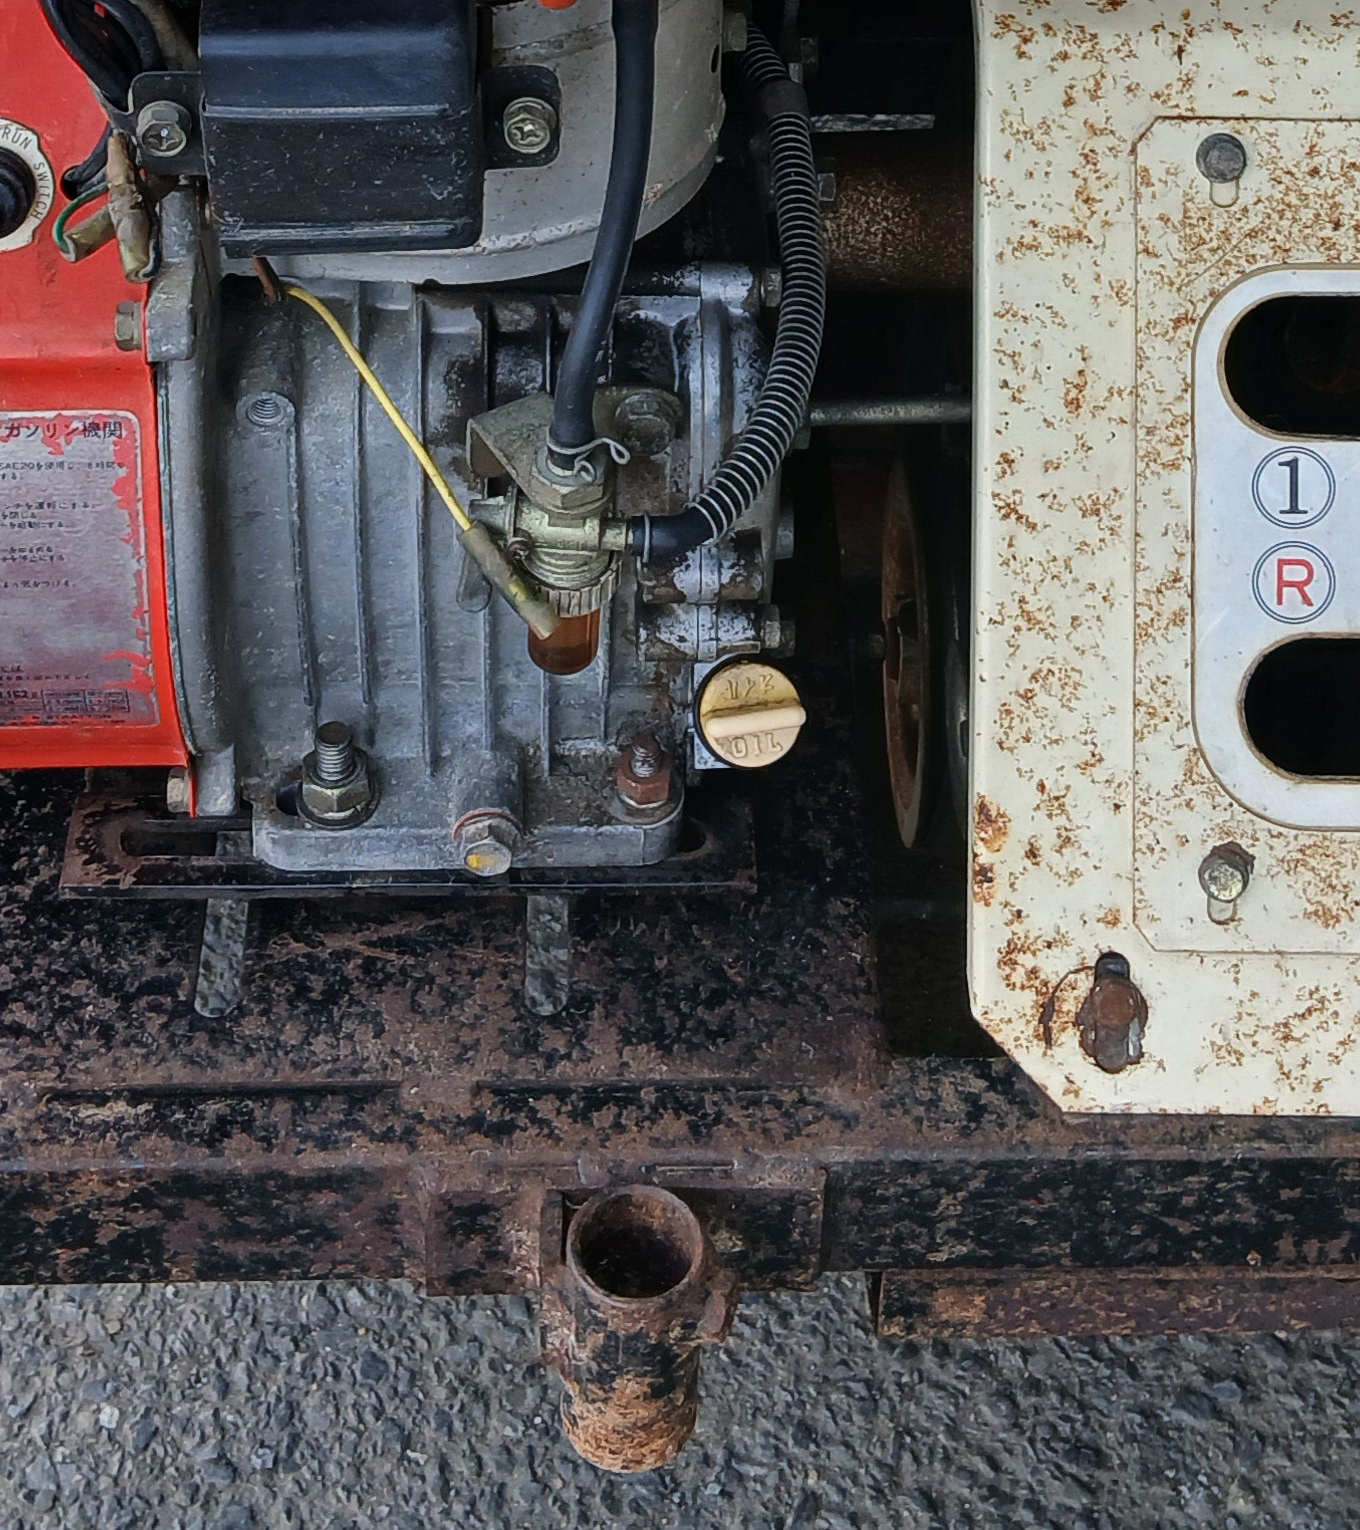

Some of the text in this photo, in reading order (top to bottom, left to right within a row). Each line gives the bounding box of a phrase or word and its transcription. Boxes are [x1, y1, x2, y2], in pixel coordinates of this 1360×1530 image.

[0, 125, 33, 151] RUN
[29, 161, 53, 221] SWITCH
[4, 420, 124, 441] ガソリン機関
[730, 732, 784, 760] OIL
